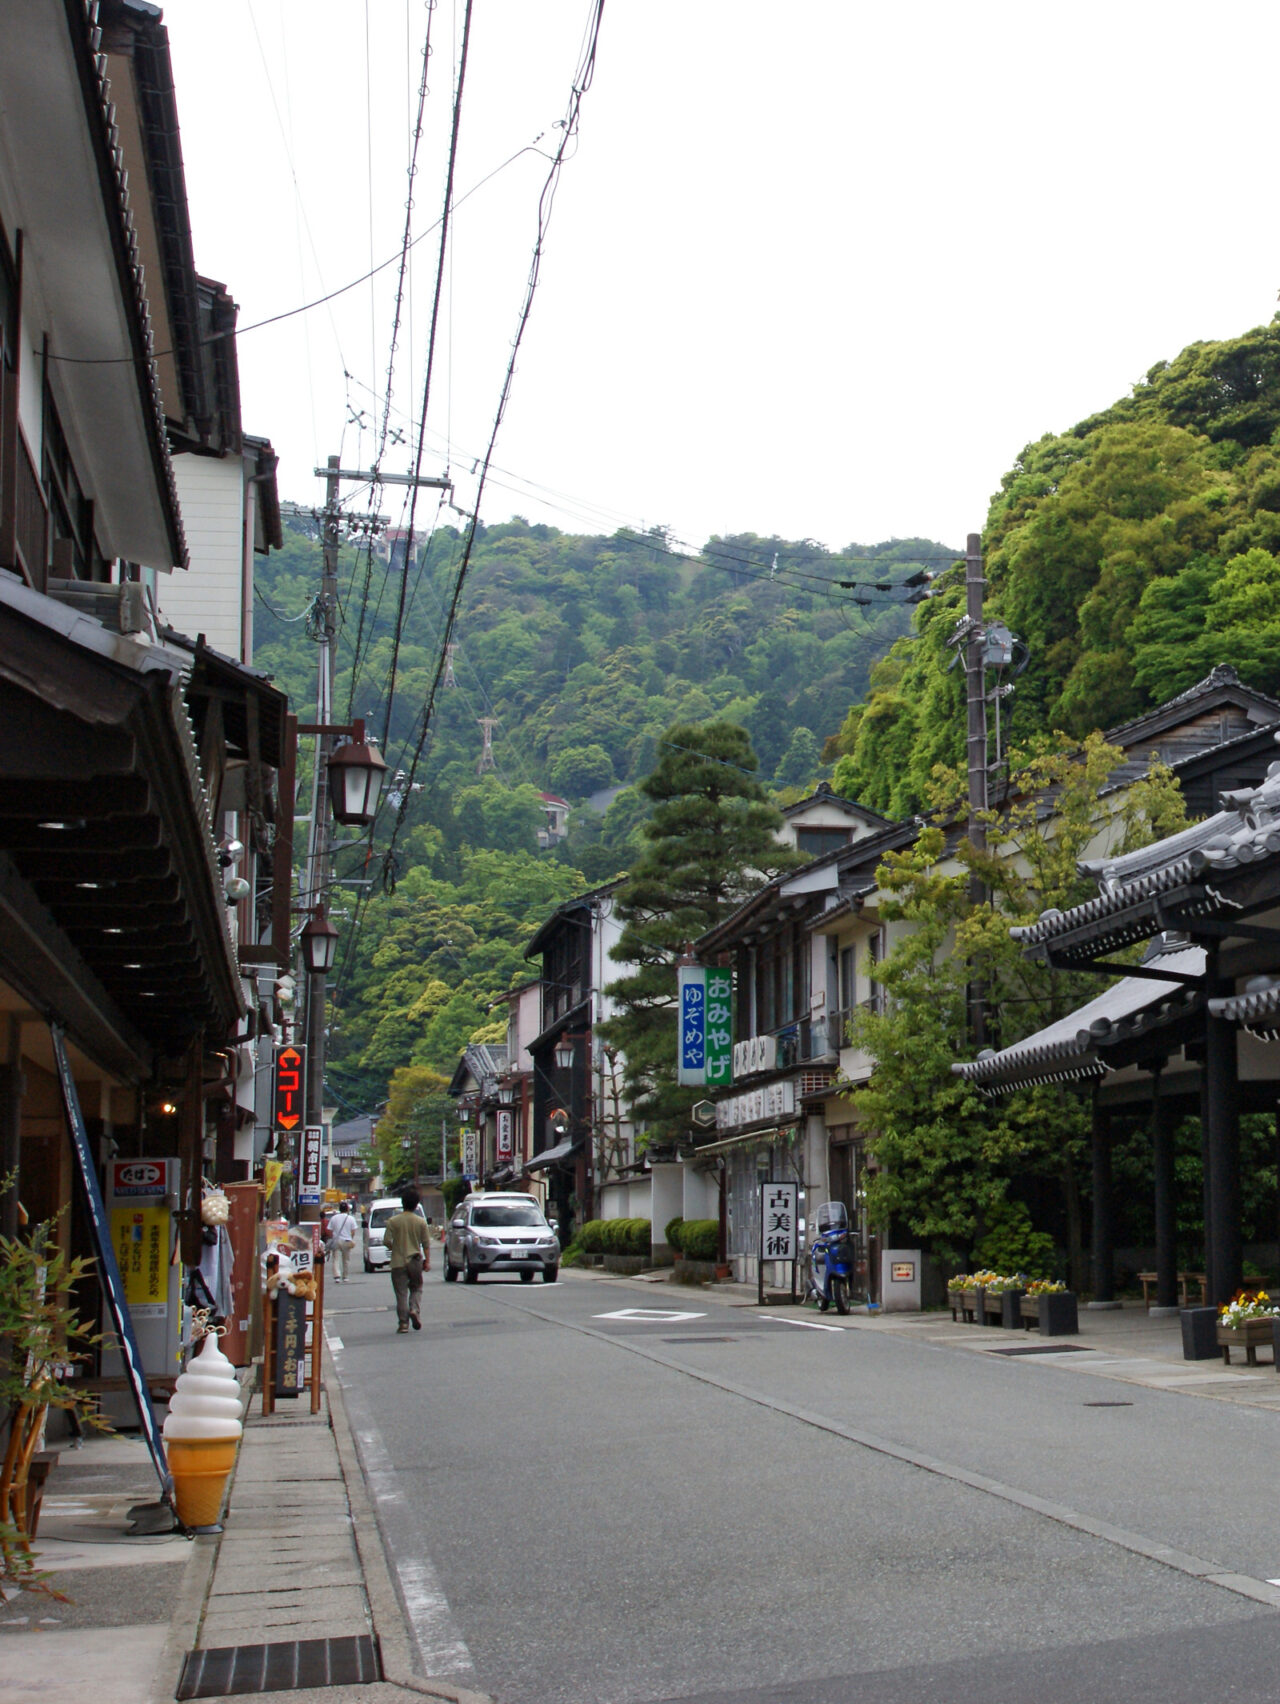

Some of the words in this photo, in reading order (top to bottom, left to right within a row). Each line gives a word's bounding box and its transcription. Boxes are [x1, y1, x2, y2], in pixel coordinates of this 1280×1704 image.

[684, 987, 704, 1065] ゆぞめや
[706, 976, 731, 1078] おみやげ
[123, 1167, 156, 1182] たばこ
[767, 1189, 791, 1256] 古美術
